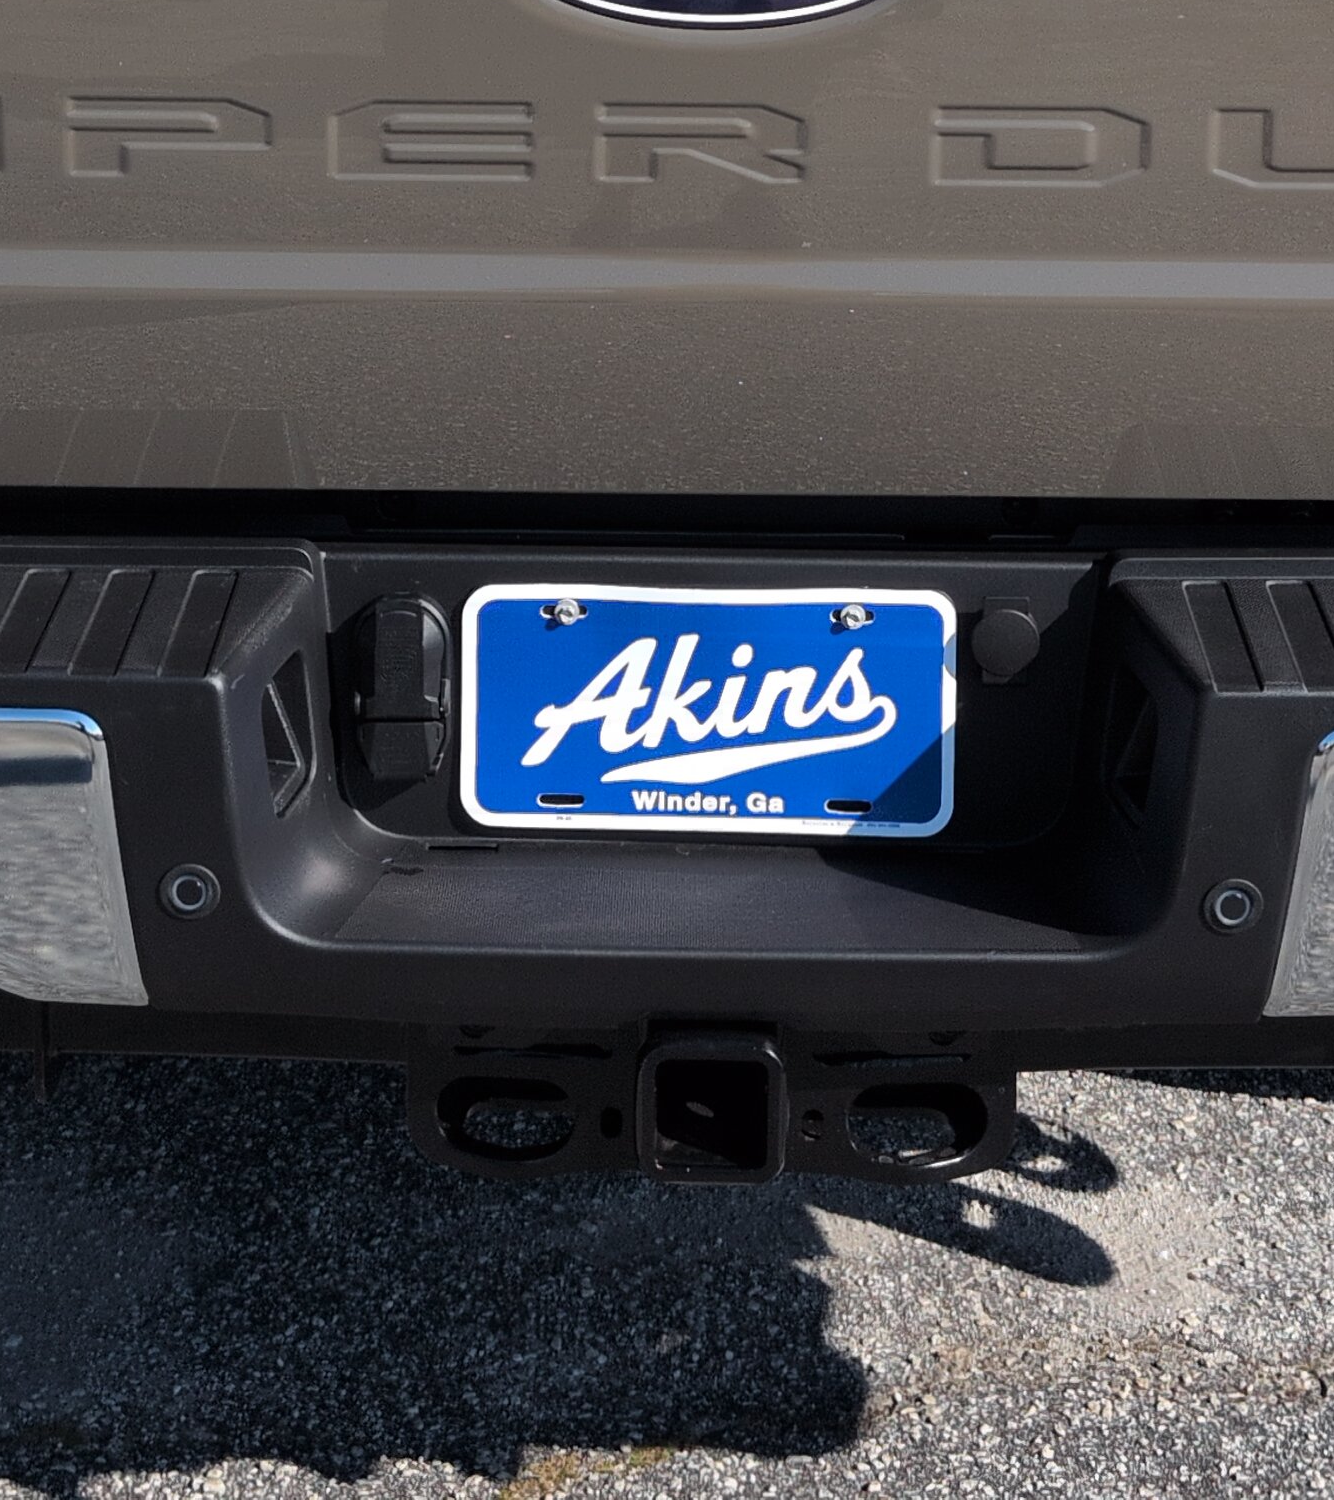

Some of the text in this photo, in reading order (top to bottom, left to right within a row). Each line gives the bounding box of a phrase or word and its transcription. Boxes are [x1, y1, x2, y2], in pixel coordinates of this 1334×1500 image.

[520, 632, 897, 767] Akins
[631, 789, 785, 815] Winder, Ga
